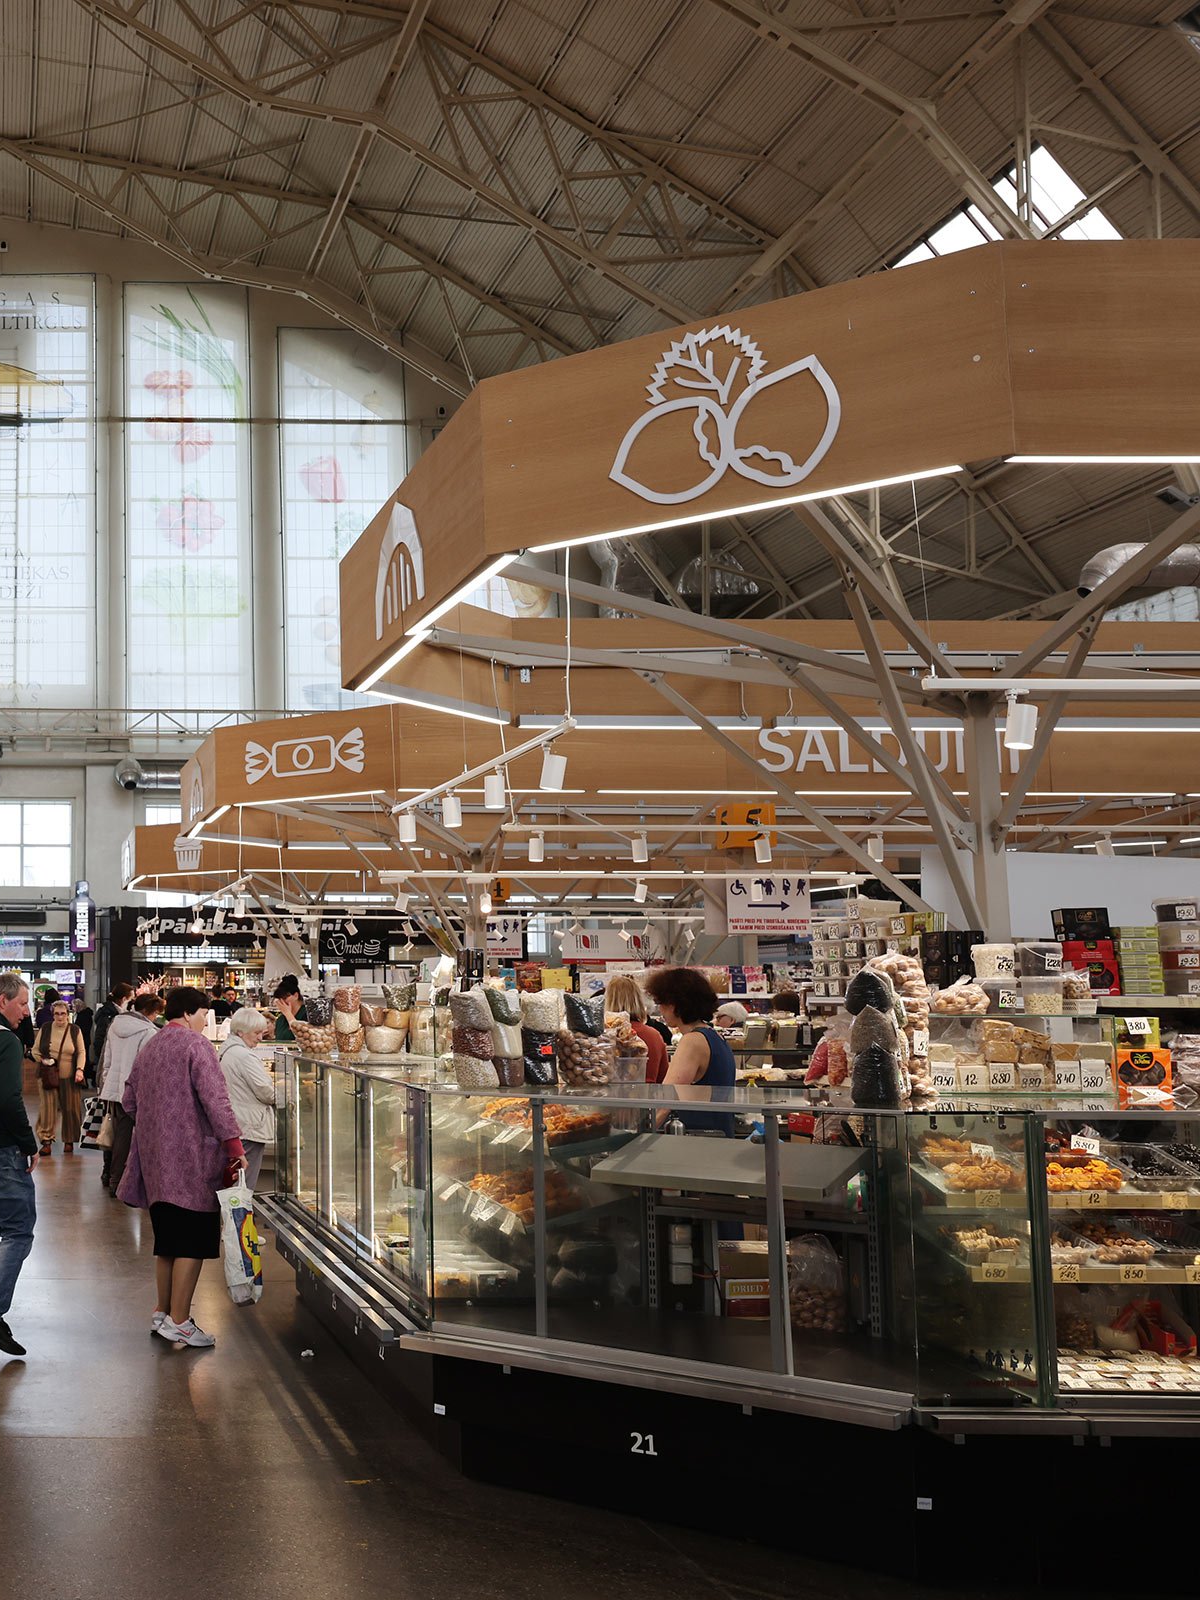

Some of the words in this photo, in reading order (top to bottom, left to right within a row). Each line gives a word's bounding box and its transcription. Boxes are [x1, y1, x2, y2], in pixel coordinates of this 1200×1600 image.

[1000, 996, 1017, 1005] 650
[1128, 1021, 1146, 1031] 380
[991, 1072, 1011, 1085] 880
[1021, 1077, 1042, 1088] 880
[1055, 1072, 1076, 1085] 840
[1082, 1076, 1104, 1088] 380
[1073, 1140, 1095, 1150] 880
[1124, 1269, 1144, 1279] 850
[732, 1283, 764, 1293] DRIED
[630, 1431, 658, 1456] 21
